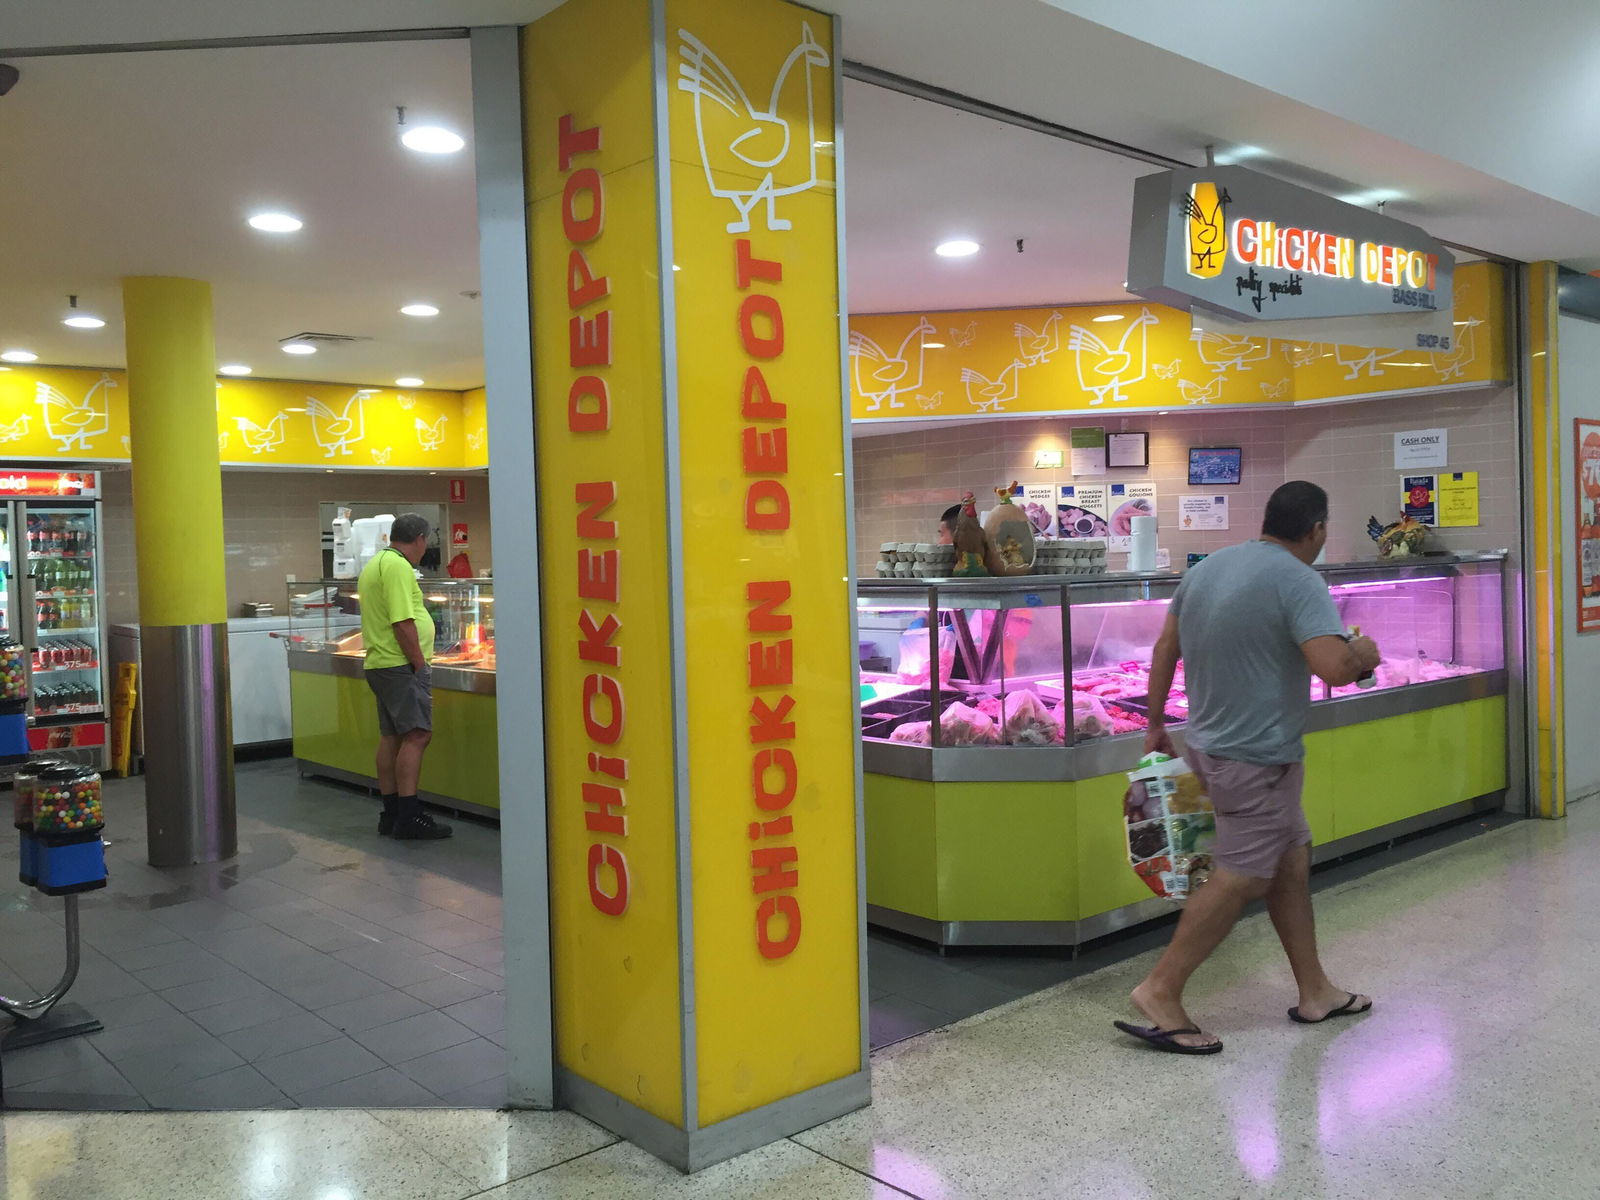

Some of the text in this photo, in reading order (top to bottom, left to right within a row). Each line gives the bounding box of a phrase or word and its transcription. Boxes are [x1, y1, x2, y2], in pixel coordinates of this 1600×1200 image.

[557, 113, 611, 436] DEPOT
[1360, 241, 1439, 290] DEPOT
[1392, 288, 1437, 310] BASS HILL
[1416, 333, 1438, 348] SHOP
[733, 239, 790, 532] DEPOT
[1401, 436, 1440, 446] CASH ONLY
